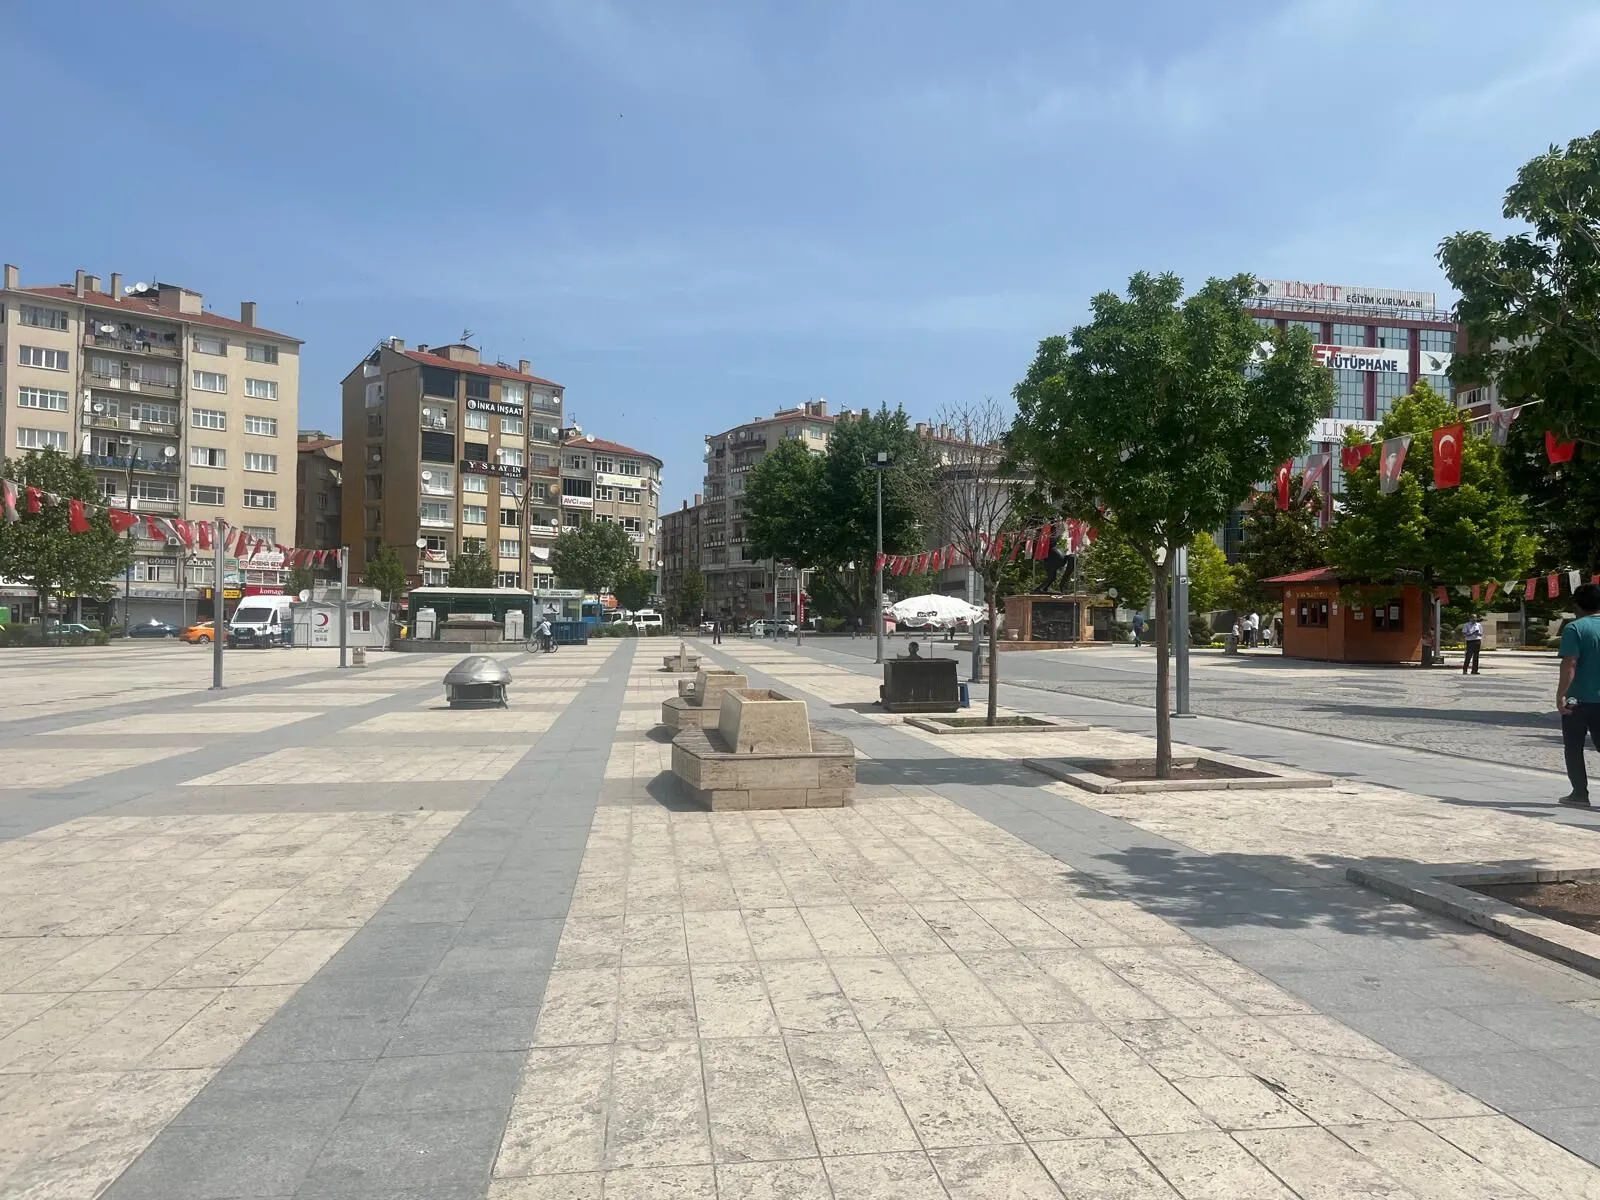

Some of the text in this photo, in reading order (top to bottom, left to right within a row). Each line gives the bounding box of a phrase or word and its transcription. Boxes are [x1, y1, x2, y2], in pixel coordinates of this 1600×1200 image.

[1285, 281, 1341, 301] LİMİT
[1346, 293, 1374, 305] EĞİTİM
[1326, 354, 1398, 372] KÜTÜPHANE
[477, 400, 523, 416] İNKA İNŞAAT
